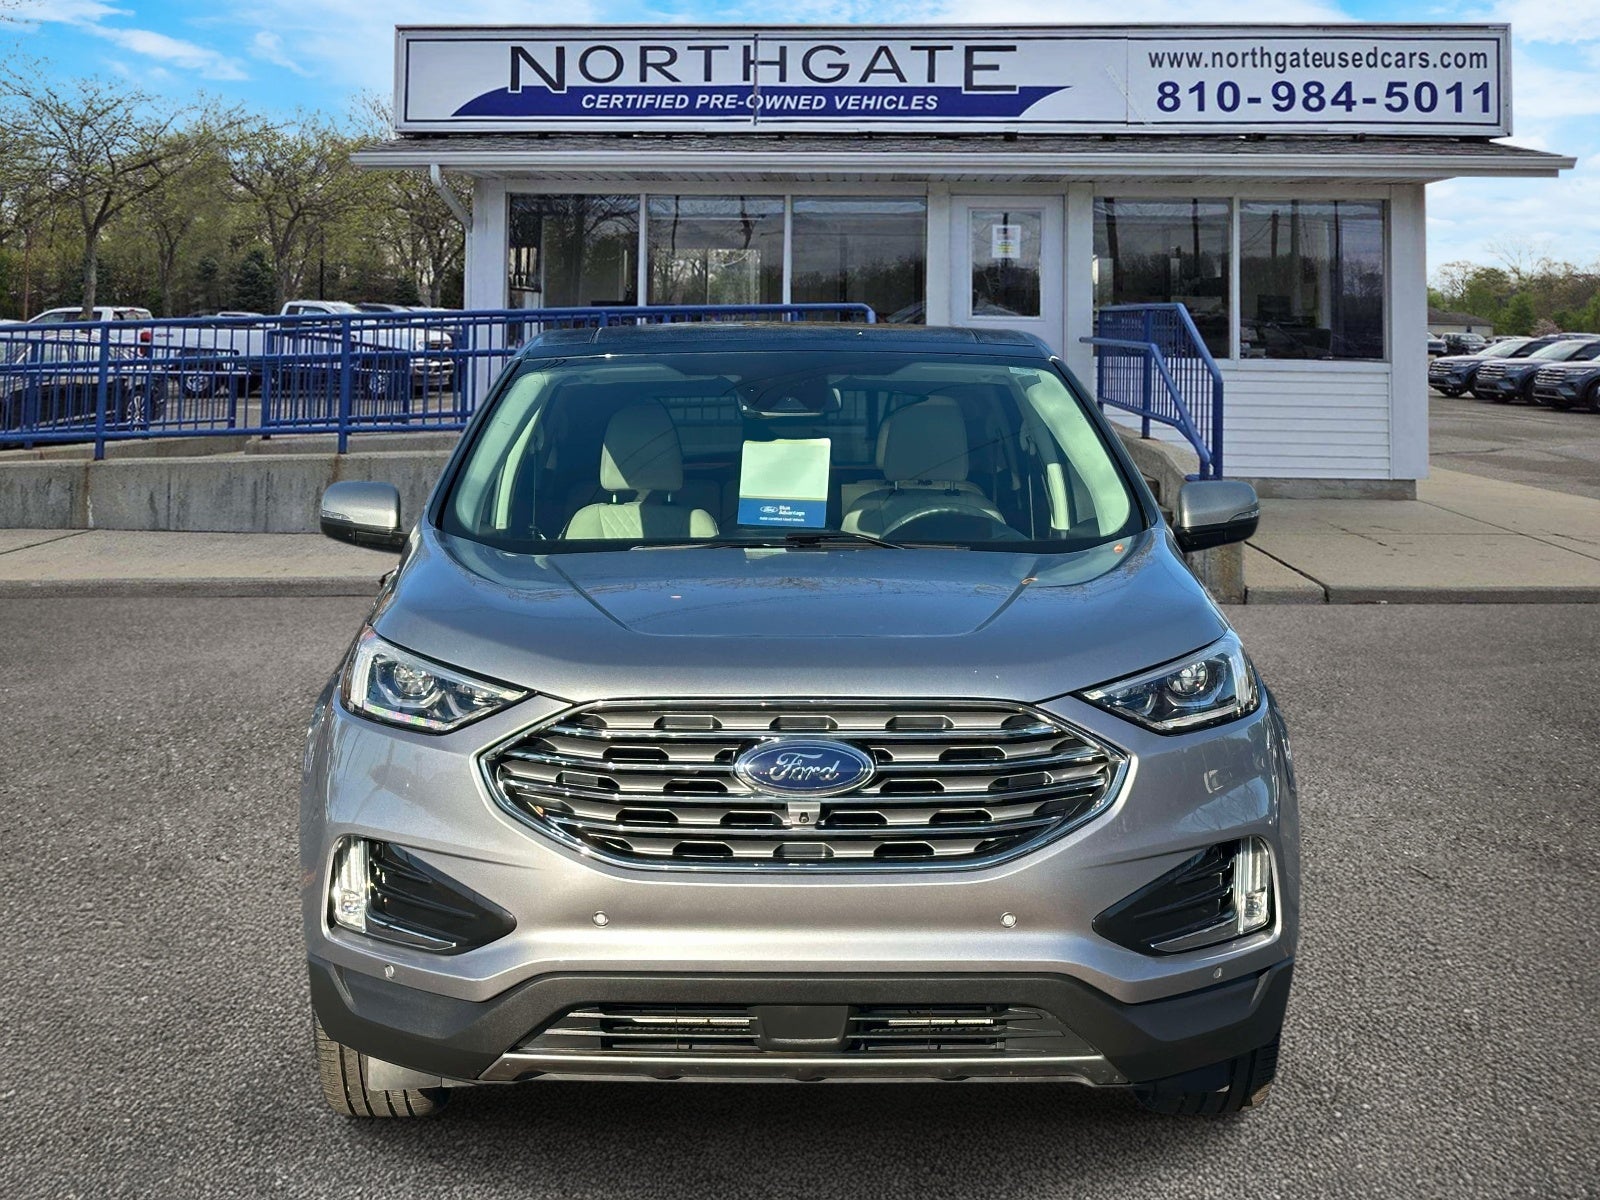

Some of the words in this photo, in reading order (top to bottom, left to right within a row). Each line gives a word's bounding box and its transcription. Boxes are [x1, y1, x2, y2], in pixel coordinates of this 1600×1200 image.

[510, 45, 1018, 92] NORTHGATE
[1148, 47, 1488, 73] www.northgateusedcars.com
[581, 93, 689, 110] CERTIFIED
[695, 94, 827, 111] PRE-OWNED
[834, 94, 939, 111] VEHICLES
[1156, 80, 1492, 113] 810-984-5011
[769, 752, 840, 781] Ford
